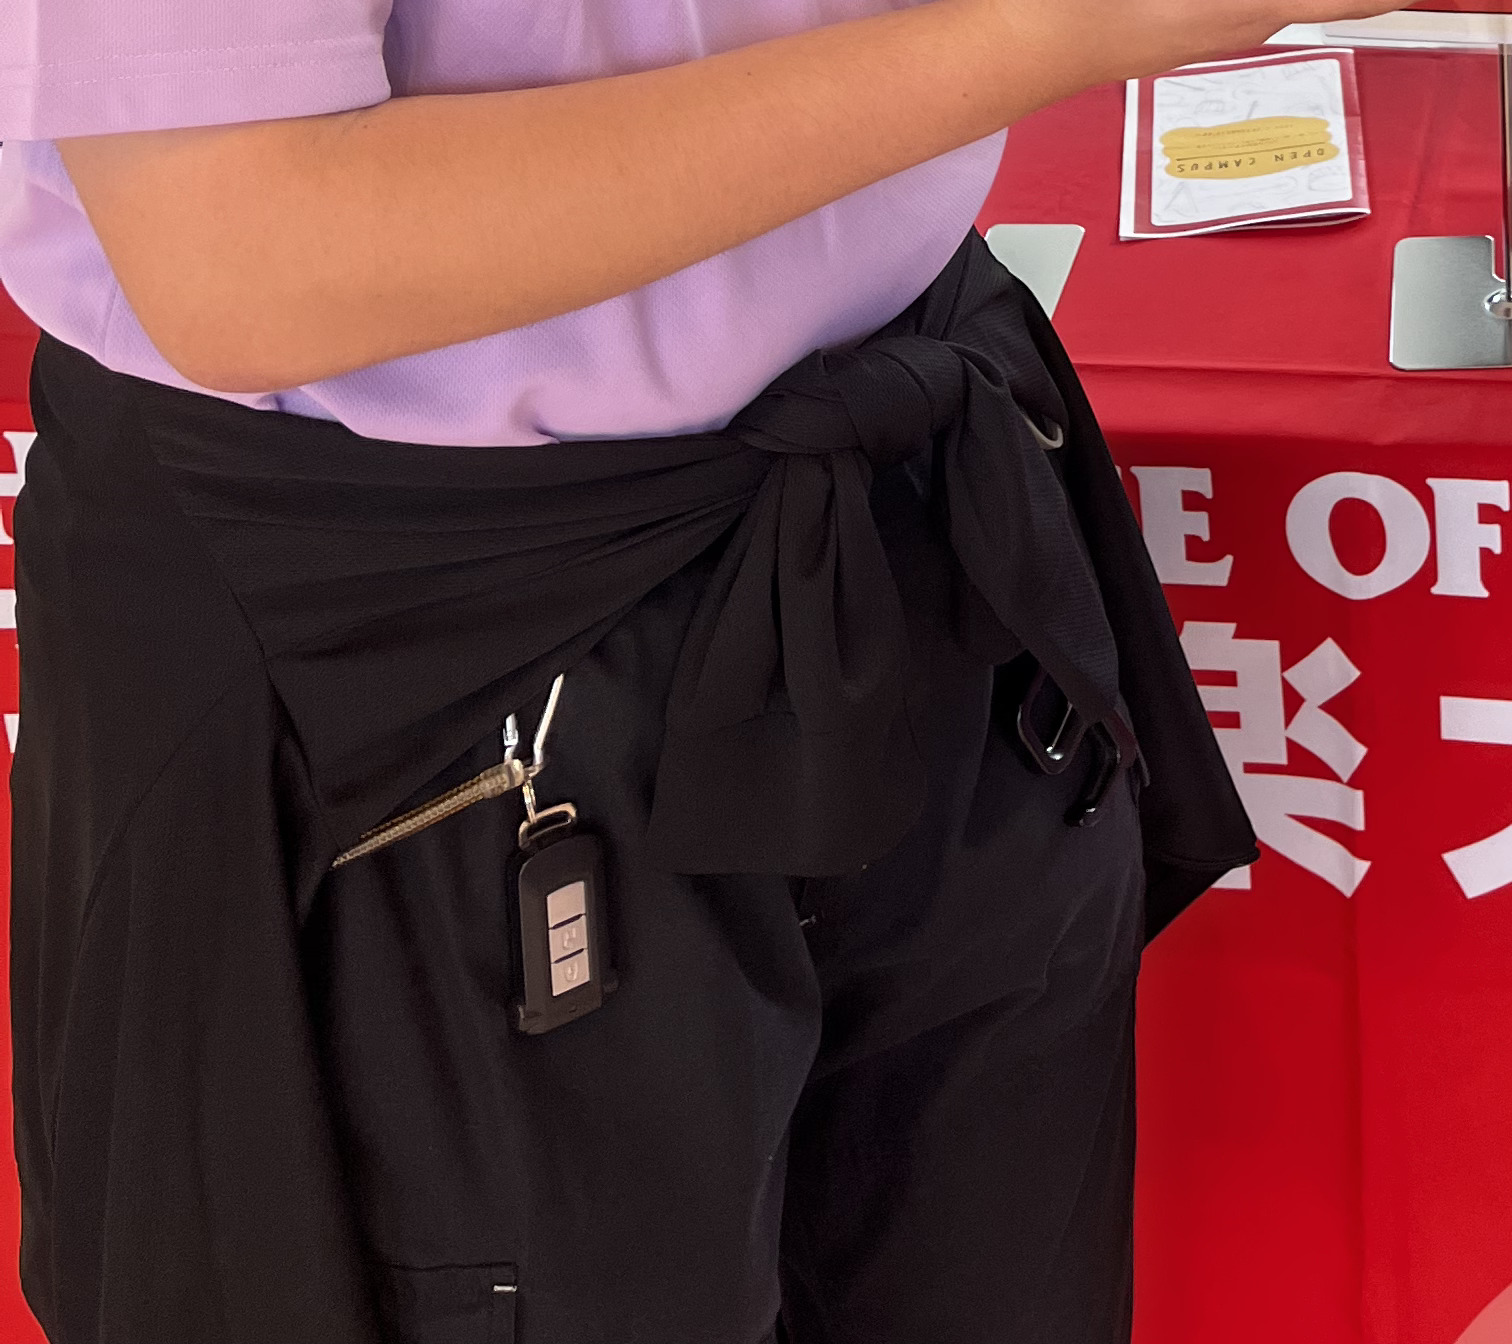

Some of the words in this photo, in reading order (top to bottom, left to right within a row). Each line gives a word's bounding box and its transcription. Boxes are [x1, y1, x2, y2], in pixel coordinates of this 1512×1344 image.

[1274, 148, 1325, 162] OPEN
[1176, 157, 1256, 173] CAMPUS
[1128, 466, 1234, 587] E
[1285, 471, 1511, 600] OF
